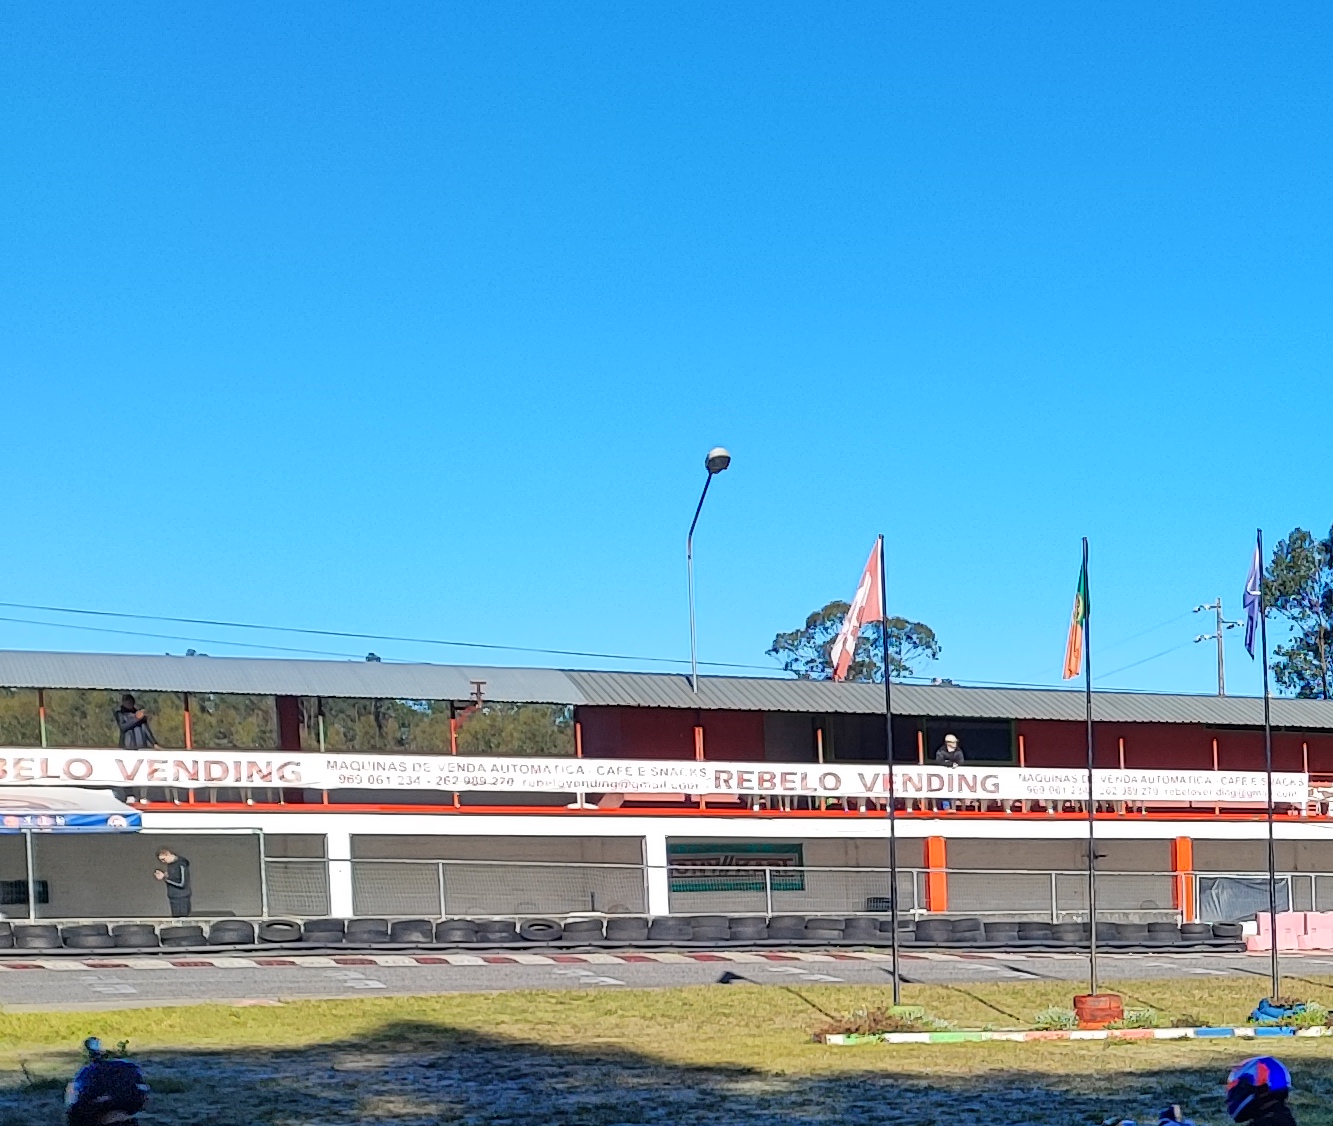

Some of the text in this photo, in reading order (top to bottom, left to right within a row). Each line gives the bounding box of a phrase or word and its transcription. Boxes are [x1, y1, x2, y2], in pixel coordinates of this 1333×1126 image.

[115, 758, 301, 783] VENDING
[412, 762, 432, 773] DE
[438, 762, 488, 773] VENDA
[650, 766, 707, 778] SNACKS
[397, 775, 421, 786] 234
[714, 769, 1000, 794] REBELO VENDING
